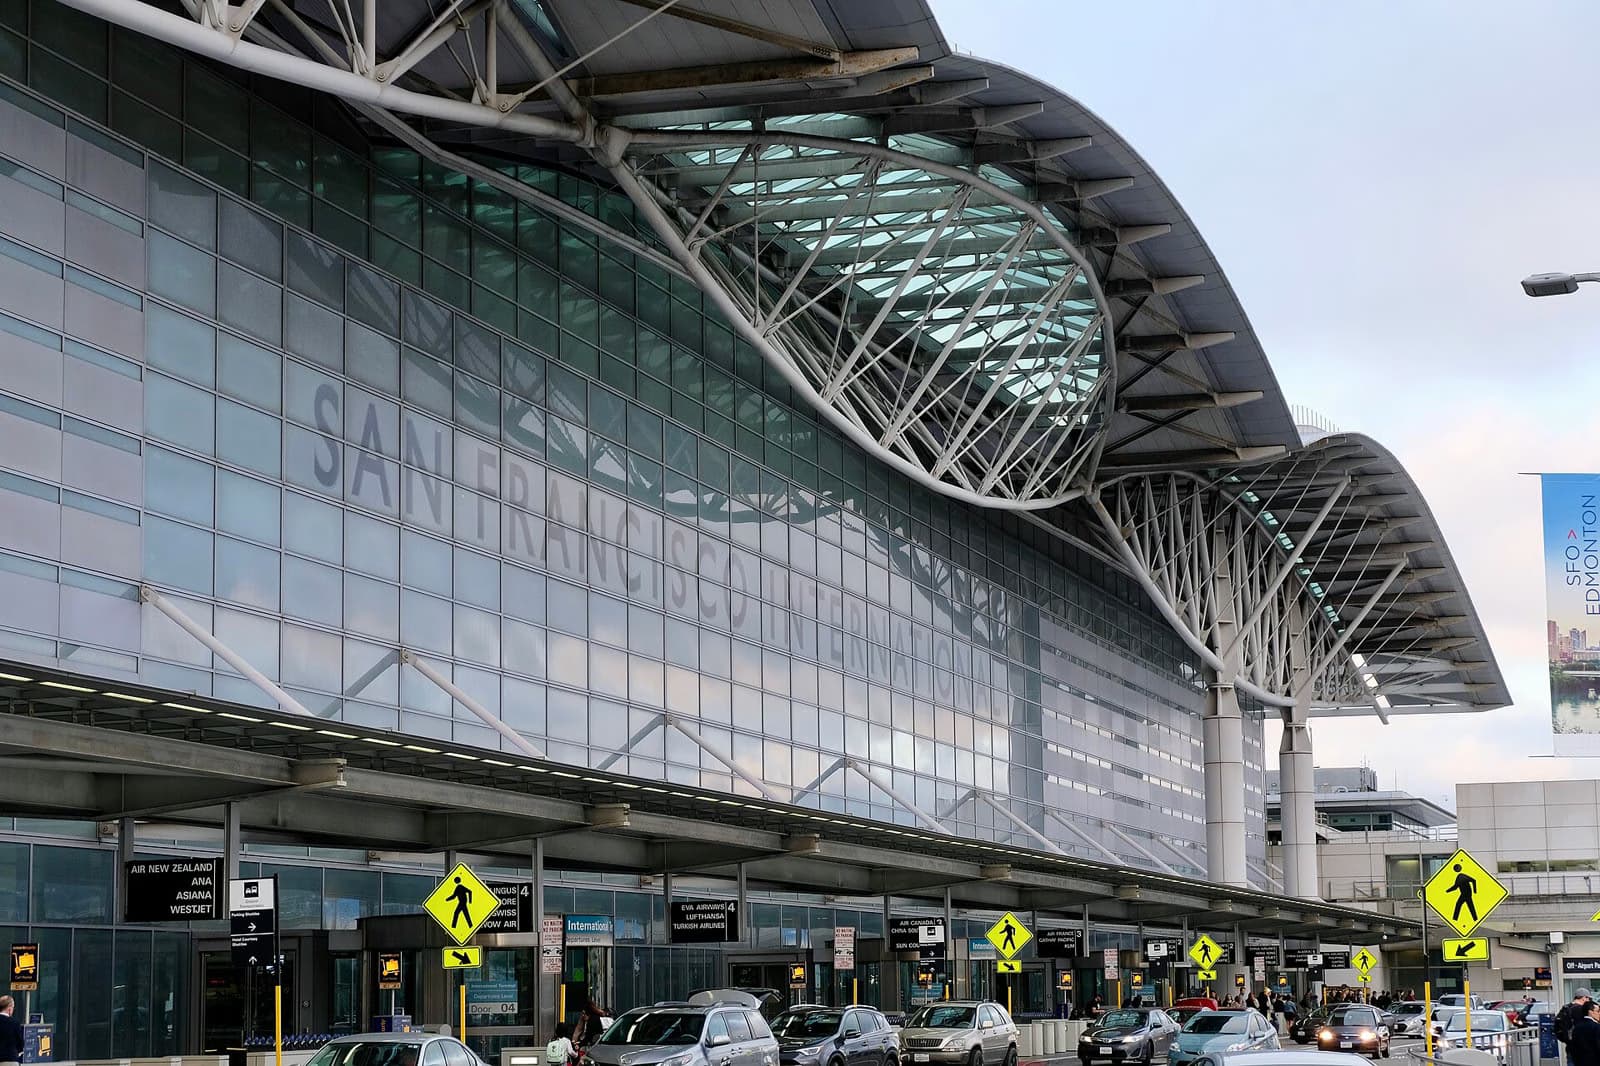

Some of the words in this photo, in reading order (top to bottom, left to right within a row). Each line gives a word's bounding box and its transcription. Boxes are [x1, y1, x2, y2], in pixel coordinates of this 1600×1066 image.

[313, 383, 442, 525] SAN
[476, 448, 748, 629] FRANCISCO
[770, 568, 1002, 718] INTERNATIONAL
[1581, 495, 1600, 616] EDMONTON
[1565, 545, 1581, 586] SFO
[131, 864, 146, 874] AIR
[148, 864, 170, 873] NEW
[172, 863, 213, 873] ZEALAND
[191, 877, 213, 886] ANA
[176, 890, 212, 900] ASIANA
[490, 886, 517, 895] INGUS
[520, 885, 529, 897] 4
[170, 904, 213, 914] WESTJET
[727, 902, 736, 913] 4
[686, 912, 725, 920] LUFTHANSA
[503, 920, 517, 928] AIR
[567, 920, 608, 931] International
[672, 922, 699, 930] TURKISH
[1076, 930, 1082, 938] 3
[471, 1004, 491, 1013] Door
[501, 1003, 516, 1013] 04
